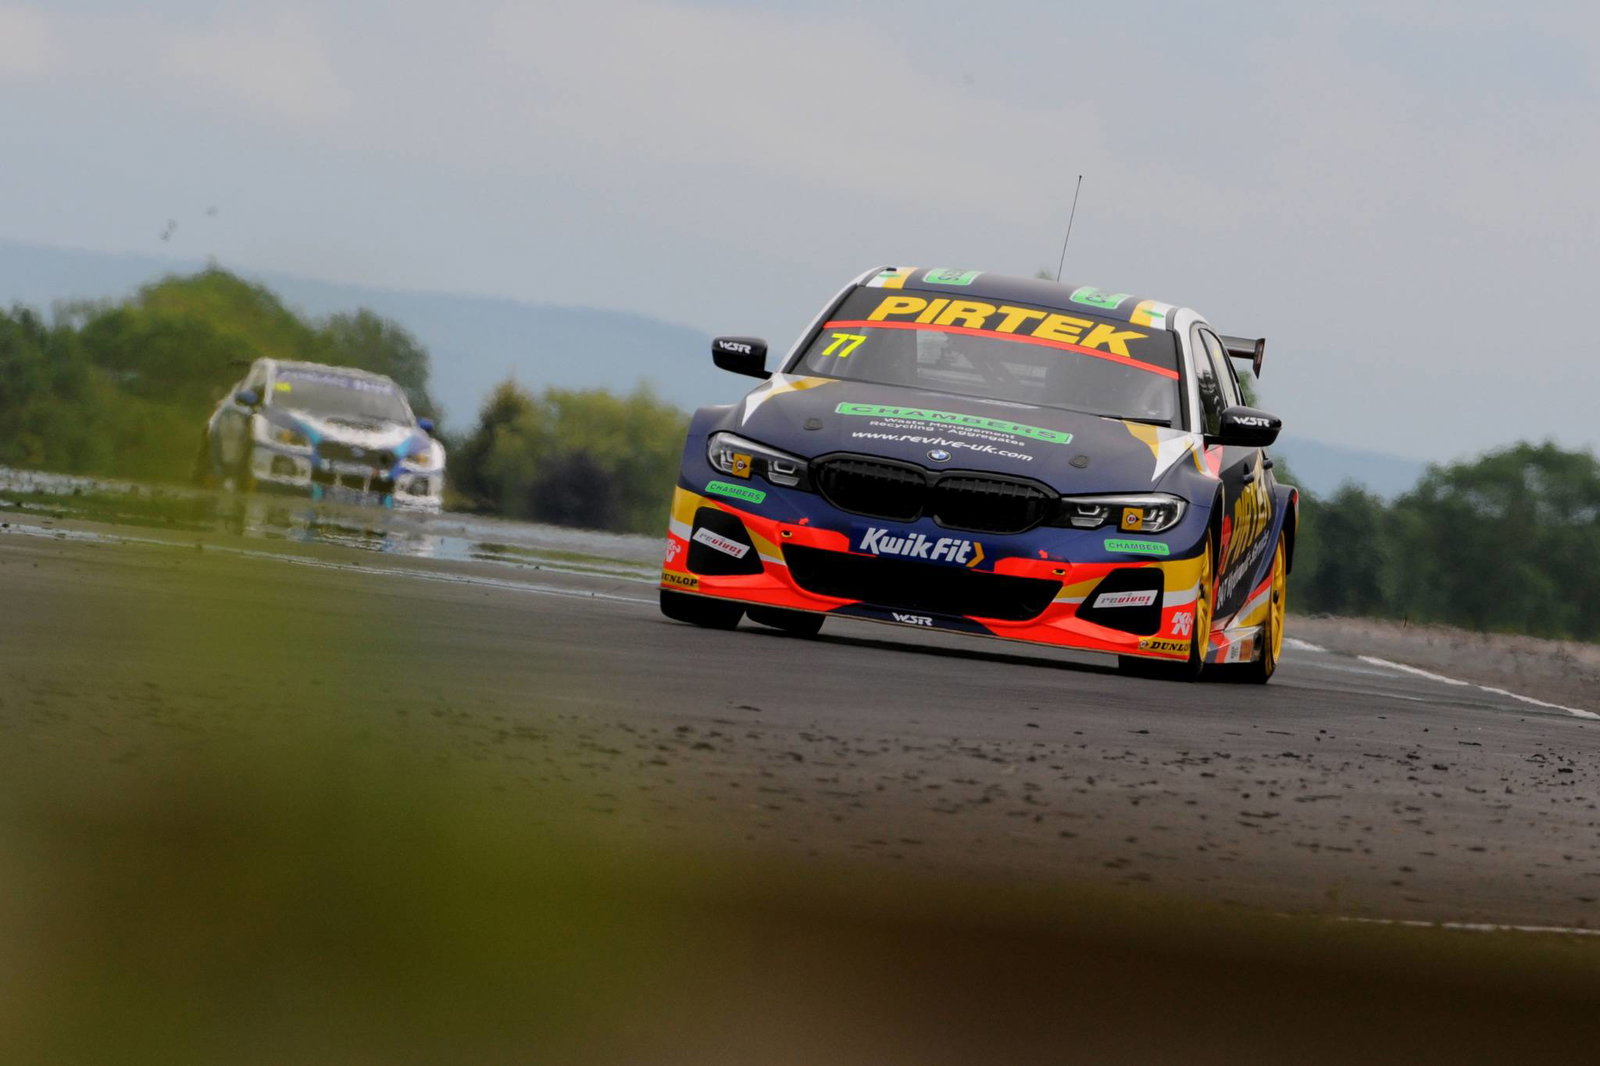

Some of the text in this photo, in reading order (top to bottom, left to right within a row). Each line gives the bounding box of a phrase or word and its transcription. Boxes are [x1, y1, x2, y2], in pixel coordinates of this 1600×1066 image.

[867, 295, 1149, 358] PIRTEK
[718, 340, 752, 354] WSR
[821, 332, 867, 358] 77
[850, 405, 1058, 439] CHAMBERS
[869, 420, 934, 432] Recycling
[947, 427, 1026, 447] Aggregates
[884, 417, 1016, 440] Waste Management
[1233, 416, 1270, 428] WSR
[851, 431, 1034, 462] www.revive-uk.com
[709, 483, 761, 501] CHAMBERS
[859, 527, 972, 564] Kwik Fit
[1108, 541, 1167, 552] CHAMBERS
[891, 611, 933, 627] WSR
